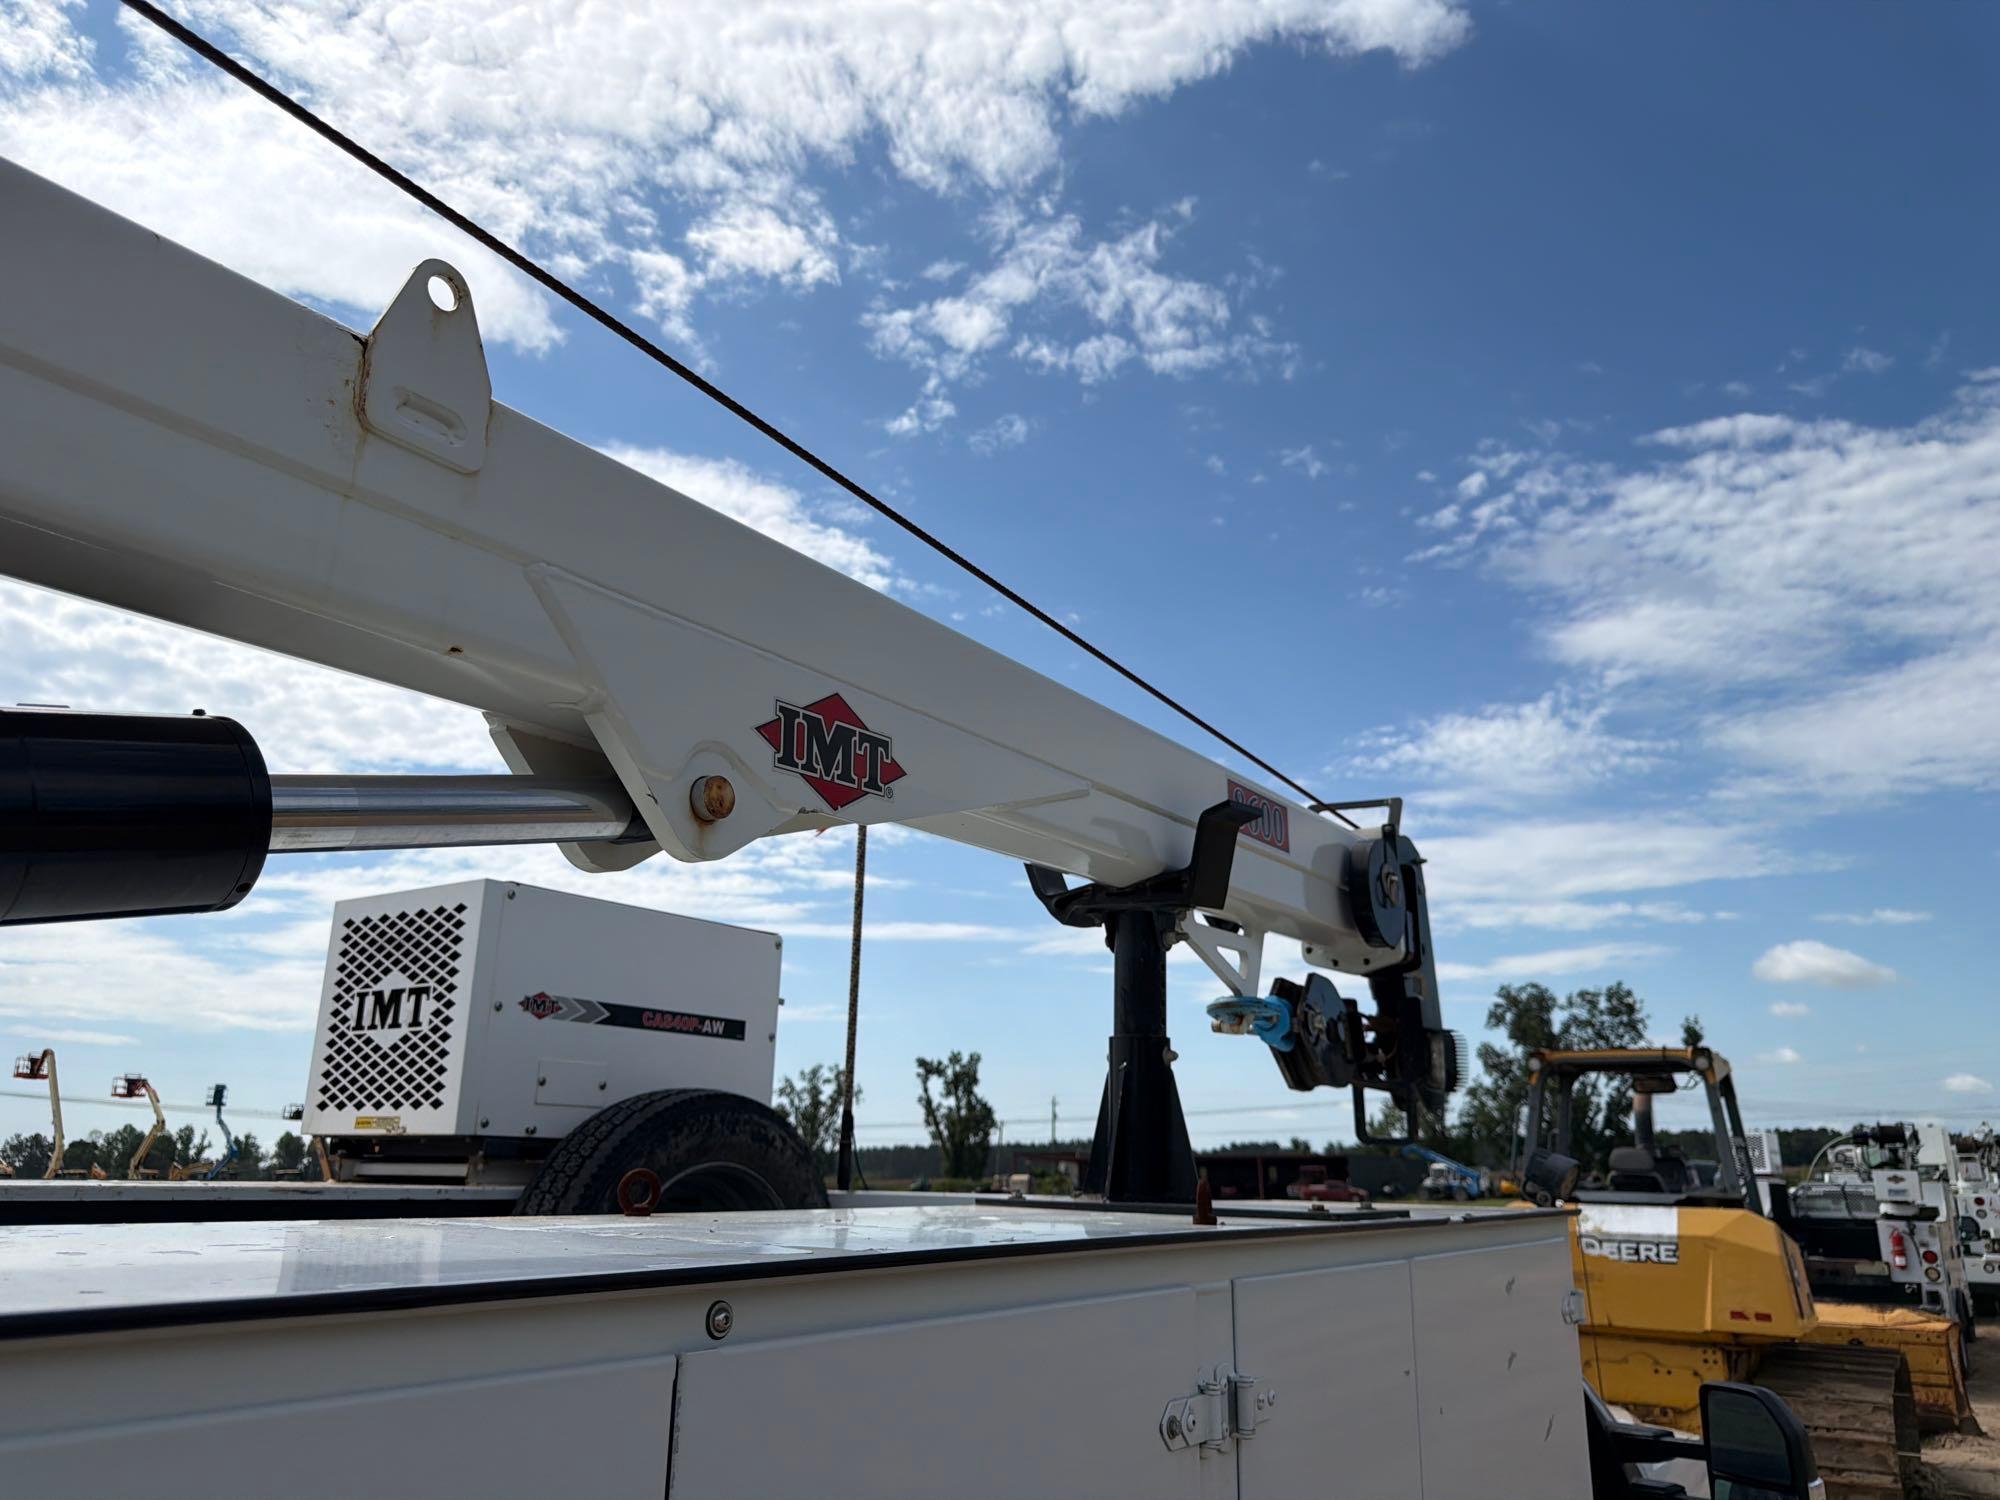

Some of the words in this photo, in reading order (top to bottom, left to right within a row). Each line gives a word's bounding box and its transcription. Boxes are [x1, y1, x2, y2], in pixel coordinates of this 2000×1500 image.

[774, 699, 892, 797] IMT
[352, 986, 431, 1031] IMT
[522, 995, 560, 1014] IMT
